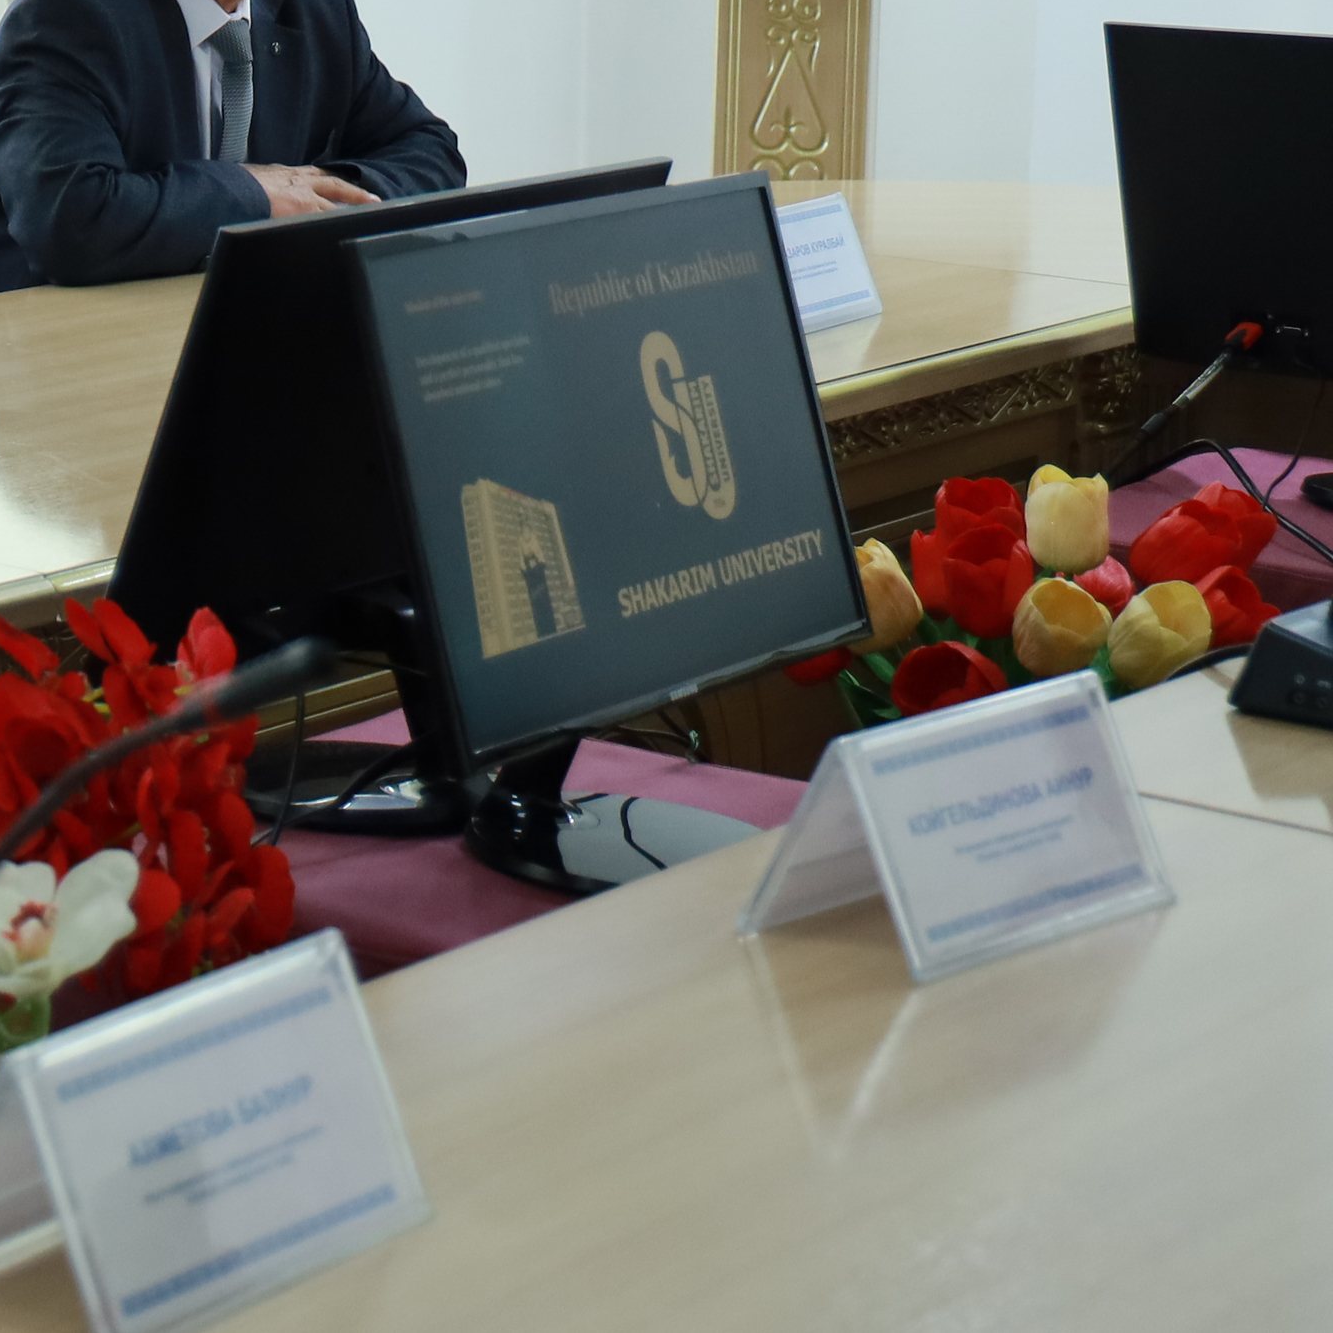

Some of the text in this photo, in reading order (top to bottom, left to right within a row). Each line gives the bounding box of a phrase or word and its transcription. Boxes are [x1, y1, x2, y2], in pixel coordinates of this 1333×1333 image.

[547, 248, 760, 317] Republic of Kazakhstan
[617, 529, 824, 619] SHAKARIM UNIVERSITY
